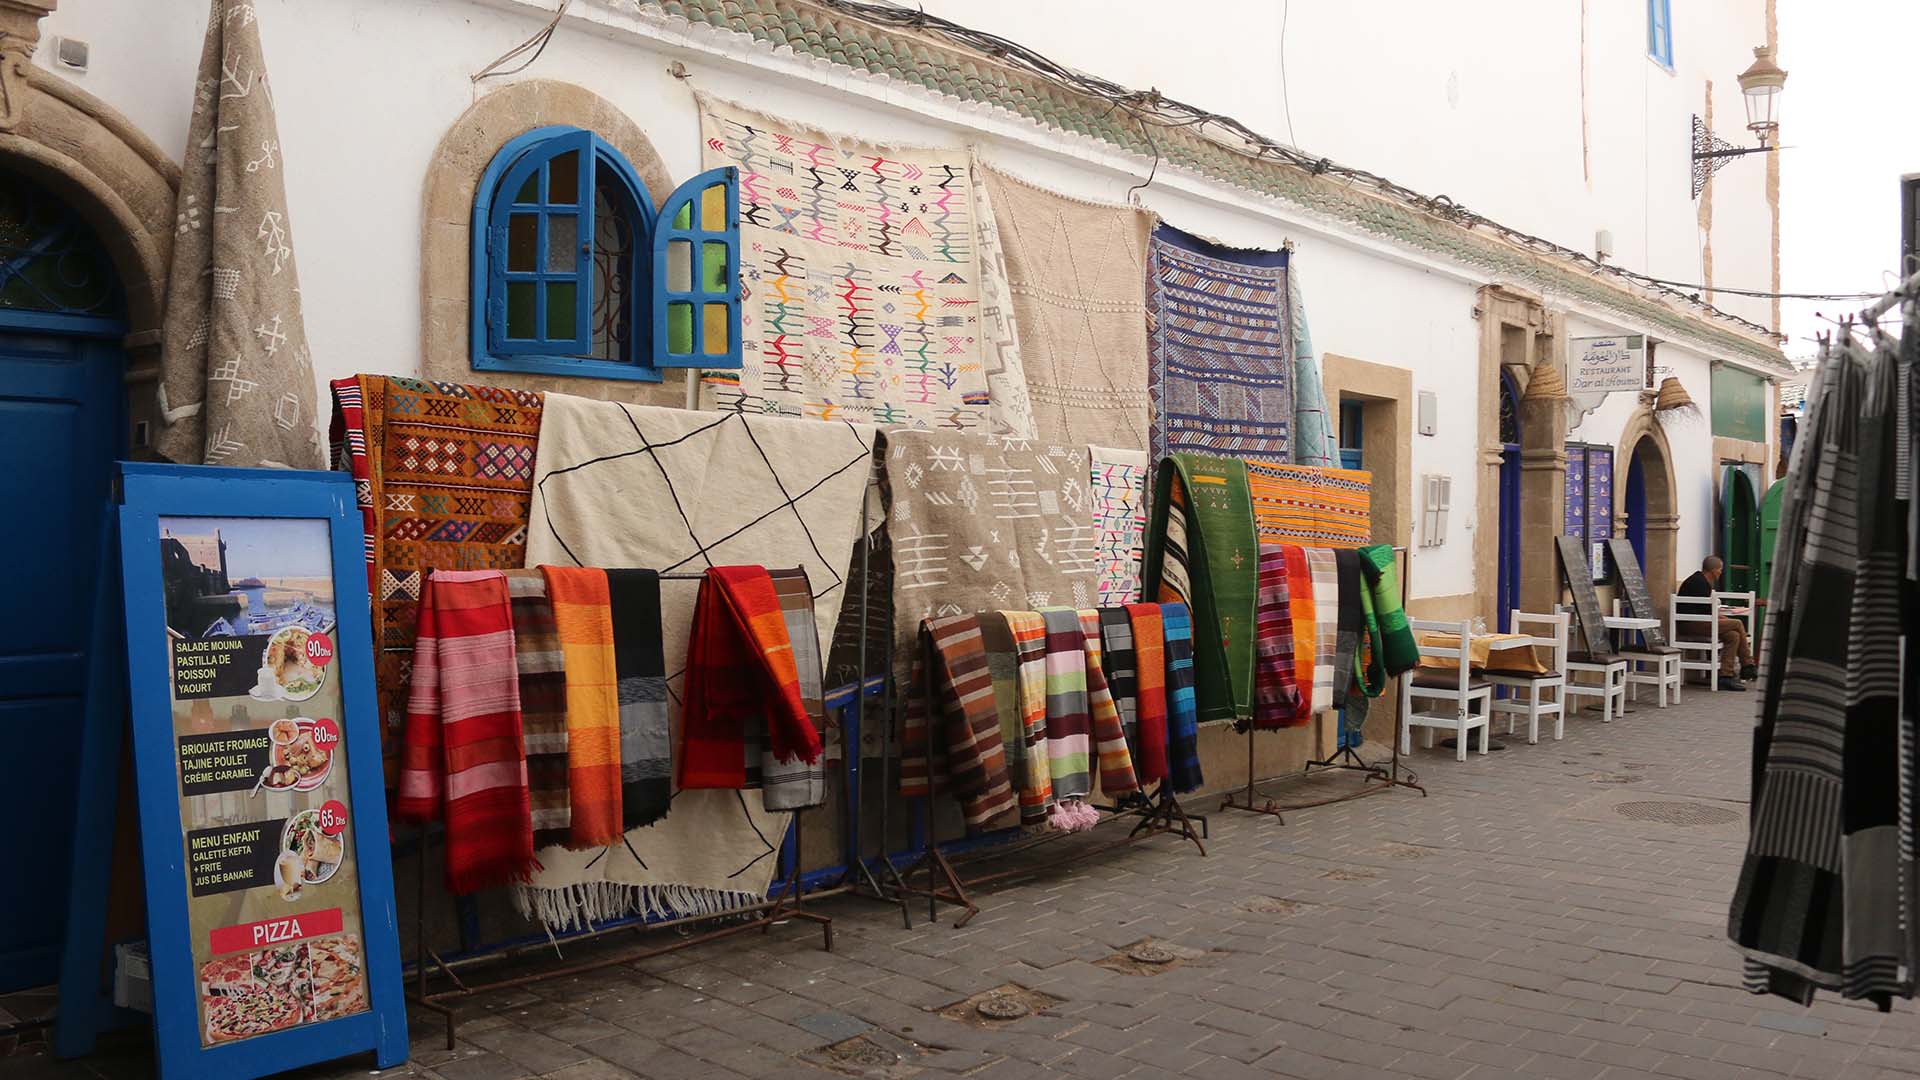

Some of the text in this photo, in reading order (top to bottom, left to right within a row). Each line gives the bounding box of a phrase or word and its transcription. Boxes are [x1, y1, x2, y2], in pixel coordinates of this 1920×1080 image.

[1580, 367, 1632, 376] RESTAURANT
[1574, 377, 1593, 388] Dar
[1594, 377, 1603, 386] al
[176, 640, 243, 653] SALADE MOUNIA
[177, 654, 231, 666] PASTILLA DE
[178, 668, 216, 680] POISSON
[178, 682, 212, 694] YAOURT
[182, 737, 269, 756] BRIOUATE FROMAGE
[183, 754, 248, 771] TAJINE POULET
[214, 768, 255, 780] CARAMEL
[321, 809, 333, 827] 65
[192, 830, 260, 850] MENU ENFANT
[193, 845, 252, 862] GALETTE KEFTA
[200, 862, 222, 873] FRITE
[195, 869, 254, 887] JUS DE BANANE
[253, 919, 303, 945] PIZZA
